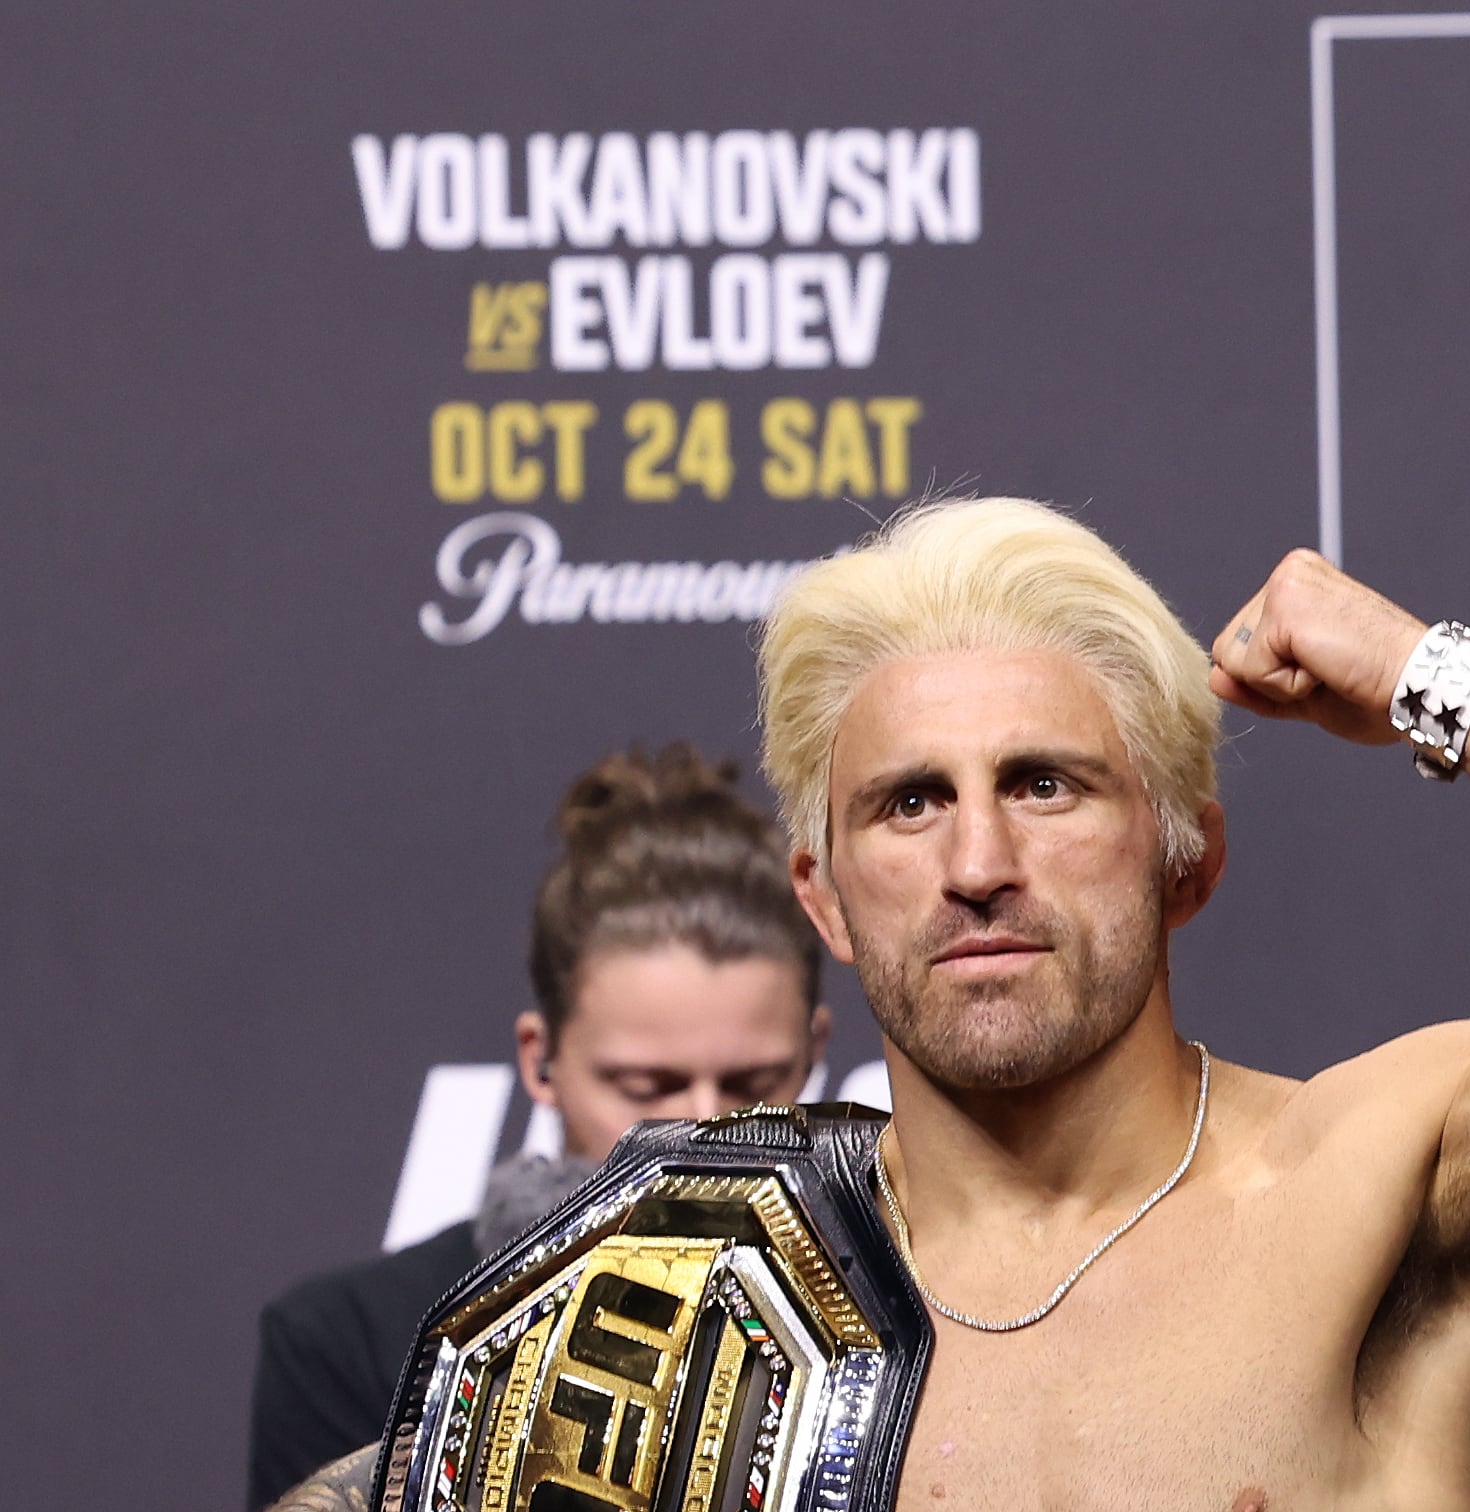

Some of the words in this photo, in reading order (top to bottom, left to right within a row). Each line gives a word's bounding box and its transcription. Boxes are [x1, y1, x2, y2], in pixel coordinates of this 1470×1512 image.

[352, 128, 980, 249] VOLKANOVSKI
[550, 253, 889, 371] EVLOEV
[431, 401, 598, 503] OCT
[624, 399, 734, 501] 24
[761, 397, 922, 499] SAT
